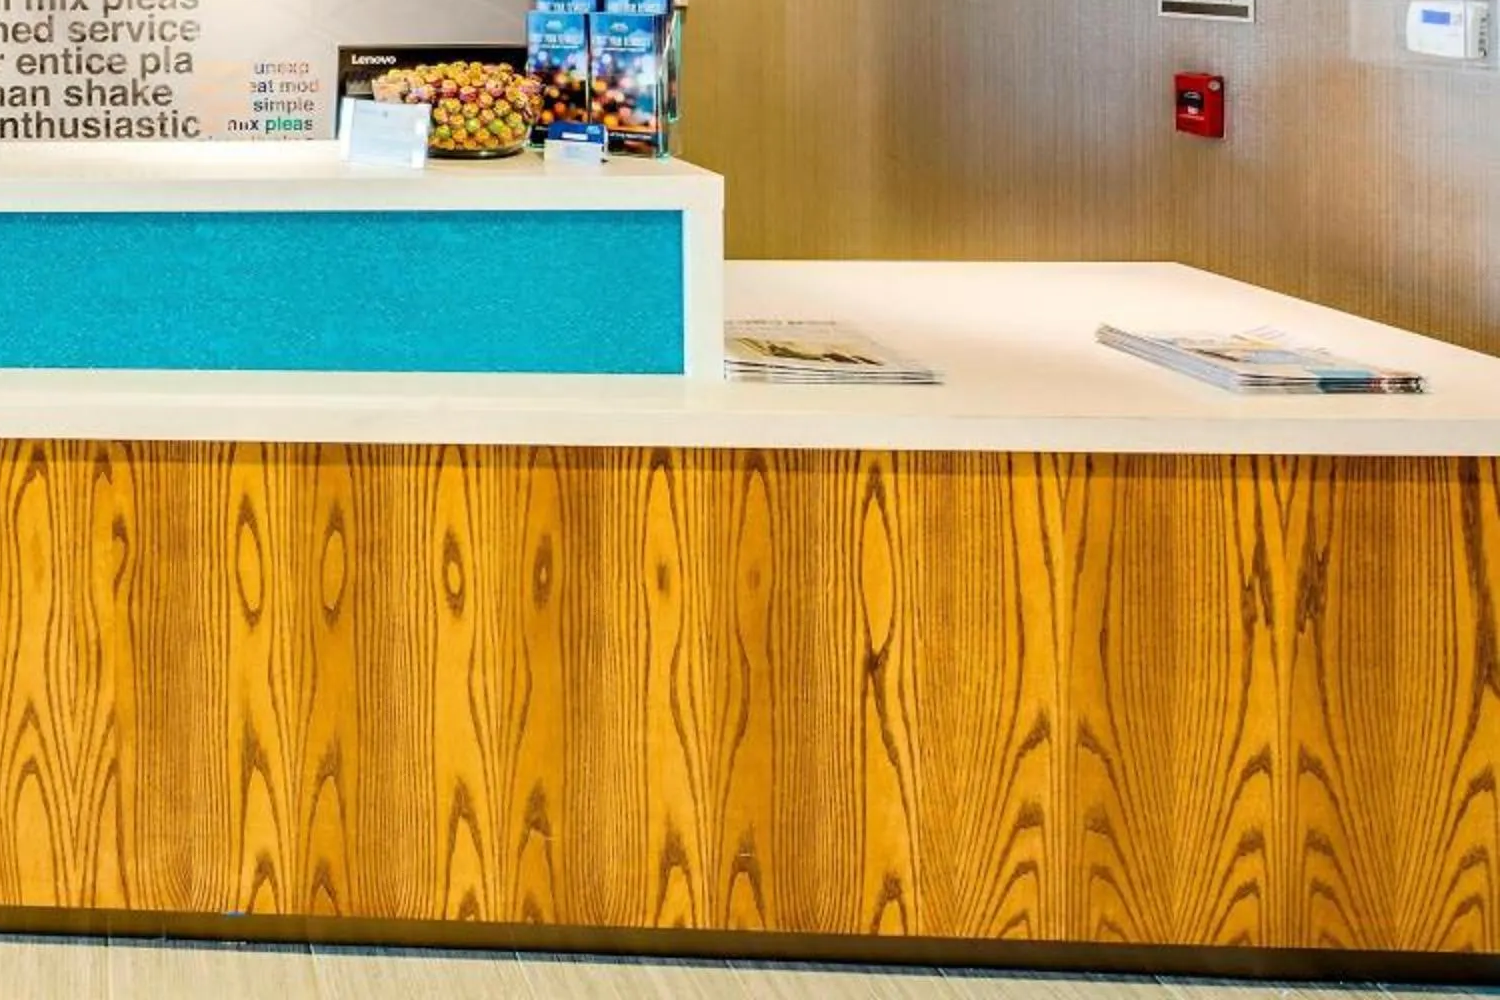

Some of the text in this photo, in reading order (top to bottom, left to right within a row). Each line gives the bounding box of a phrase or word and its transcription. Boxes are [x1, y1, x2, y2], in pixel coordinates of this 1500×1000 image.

[68, 14, 201, 43] service
[16, 47, 128, 76] entice
[140, 46, 194, 80] pla
[351, 54, 397, 65] Lenovo
[64, 79, 174, 108] shake
[253, 98, 315, 113] simple
[265, 116, 313, 134] pleas
